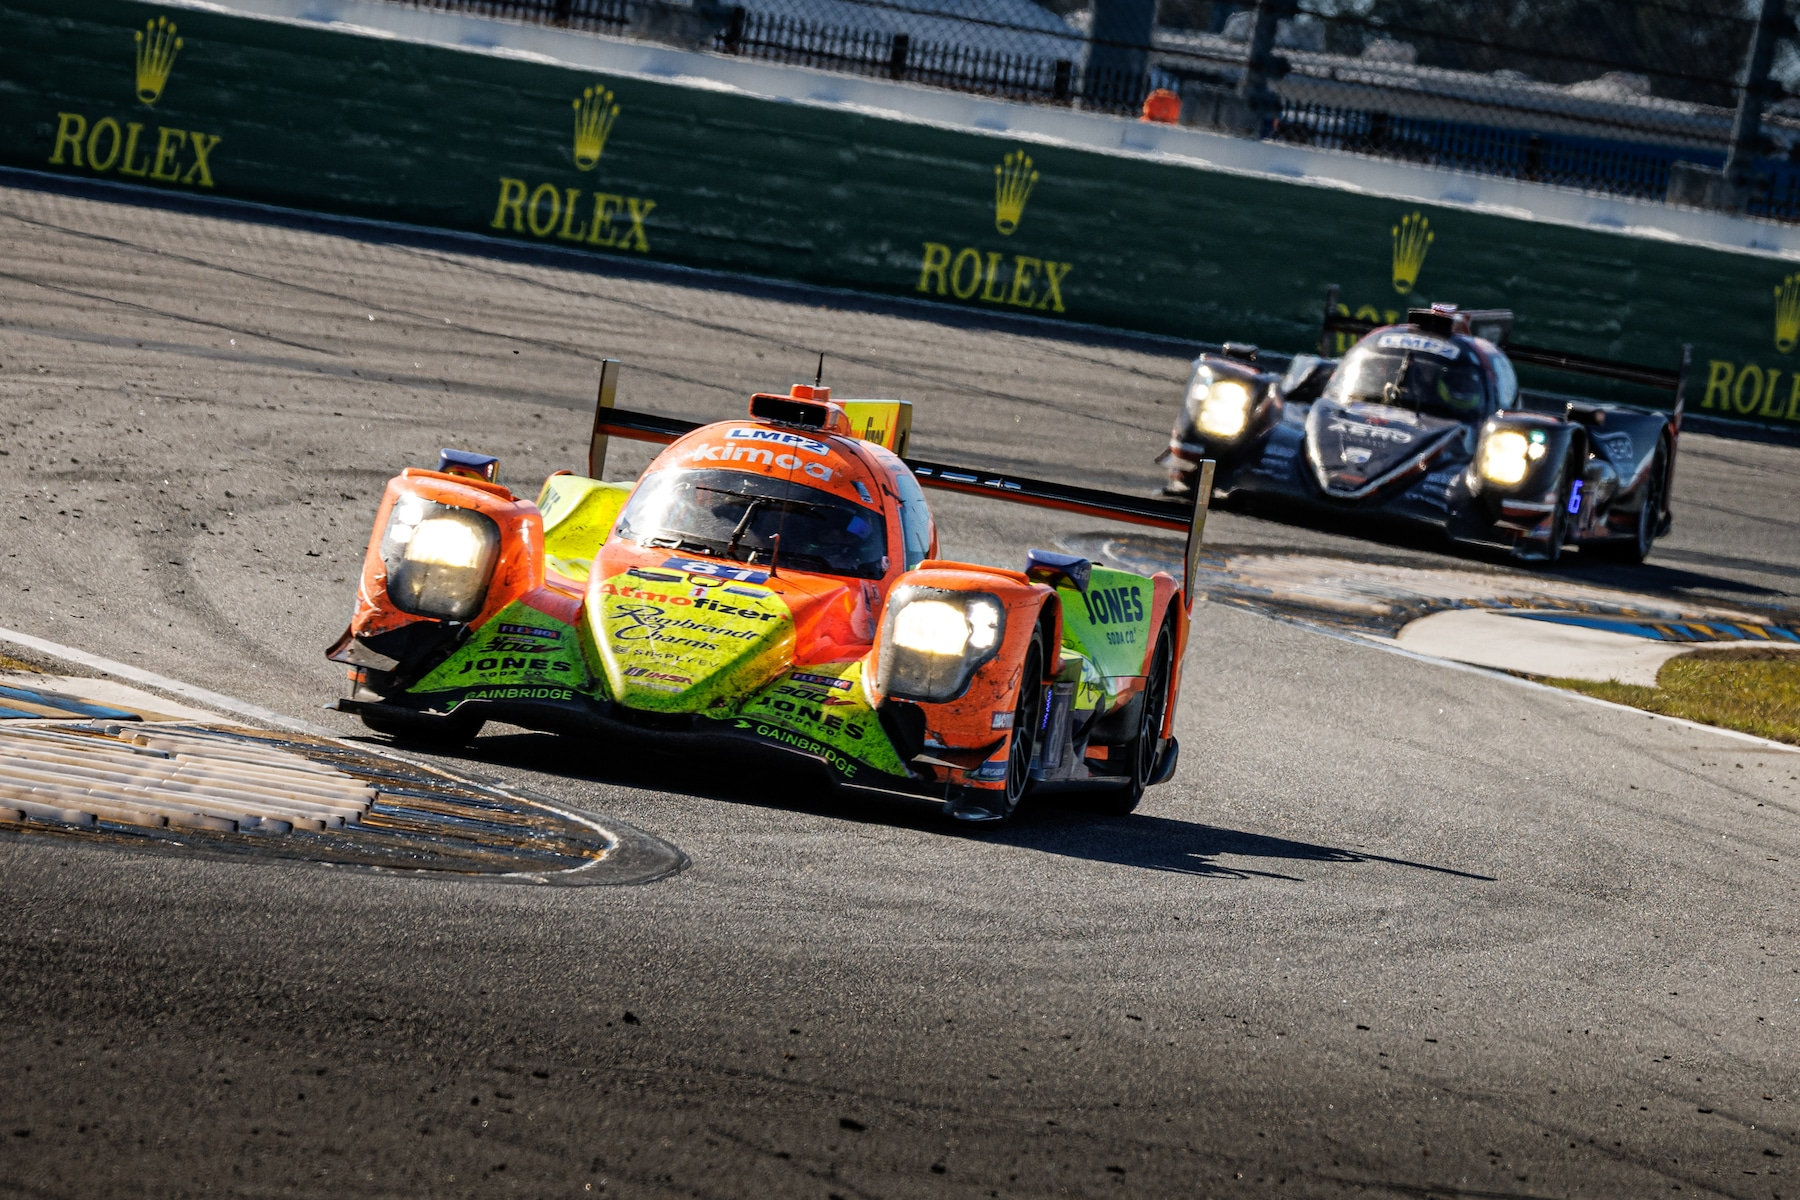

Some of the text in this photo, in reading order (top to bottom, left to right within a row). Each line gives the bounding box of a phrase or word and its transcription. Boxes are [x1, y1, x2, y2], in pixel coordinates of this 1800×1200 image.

[49, 112, 221, 188] ROLEX
[490, 177, 657, 253] ROLEX
[916, 242, 1074, 314] ROLEX
[731, 429, 826, 453] LMP2
[688, 442, 834, 482] kimoa
[681, 560, 754, 582] 81
[600, 583, 777, 621] Atmofizer
[1083, 585, 1145, 626] JONES
[609, 603, 760, 641] Rembrandt
[614, 623, 720, 651] Charms
[1106, 631, 1125, 645] SODA
[459, 656, 572, 675] JONES
[479, 670, 522, 678] SODA
[464, 688, 573, 701] GAINBRIDGE
[755, 696, 865, 740] JONES
[775, 711, 812, 728] SODA
[756, 724, 858, 779] GAINBRIDGE
